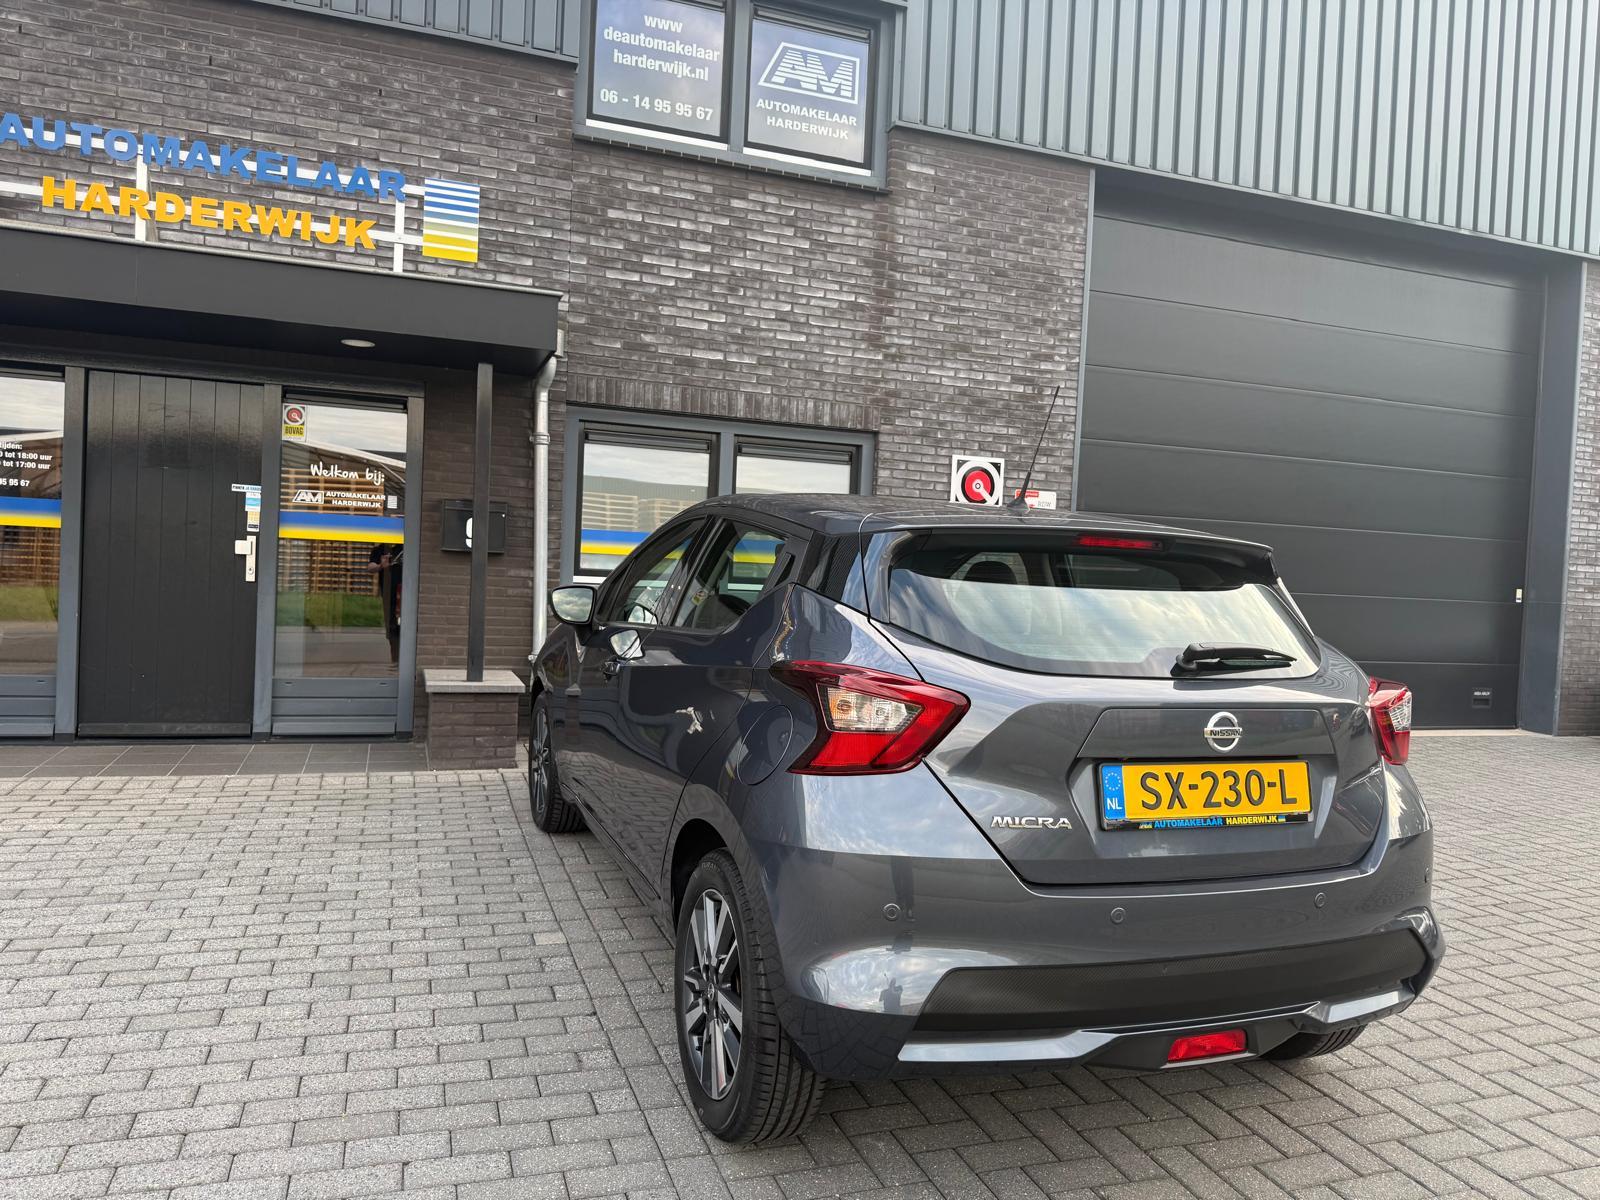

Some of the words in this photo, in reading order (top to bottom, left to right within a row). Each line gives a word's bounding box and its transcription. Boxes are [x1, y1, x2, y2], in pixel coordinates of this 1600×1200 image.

[643, 14, 683, 33] www
[603, 26, 720, 61] deautomakelaar
[613, 48, 709, 81] harderwijk.nl
[600, 88, 618, 104] 06
[632, 94, 650, 110] 14
[653, 98, 672, 114] 95
[675, 102, 693, 118] 95
[696, 106, 713, 121] 67
[756, 98, 857, 126] AUTOMAKELAAR
[766, 115, 849, 140] HARDERWIJK
[0, 112, 407, 201] AUTOMAKELAAR
[42, 176, 377, 250] HARDERWIJK
[4, 451, 16, 459] tot
[17, 452, 38, 460] 18:00
[15, 461, 36, 469] 17:00
[8, 478, 19, 486] 95
[20, 479, 30, 487] 67
[310, 461, 359, 480] Welkom
[365, 468, 385, 486] bij:
[325, 491, 386, 501] AUTOMAKELAAR
[331, 499, 381, 508] HARDERWIJK
[1210, 729, 1241, 737] NISSAN
[1140, 769, 1298, 811] SX-230-L
[1107, 798, 1122, 811] NL
[991, 815, 1073, 830] MICRA
[1154, 817, 1223, 828] AUTOMAKELAAR
[1226, 815, 1278, 825] HARDERWIJK
